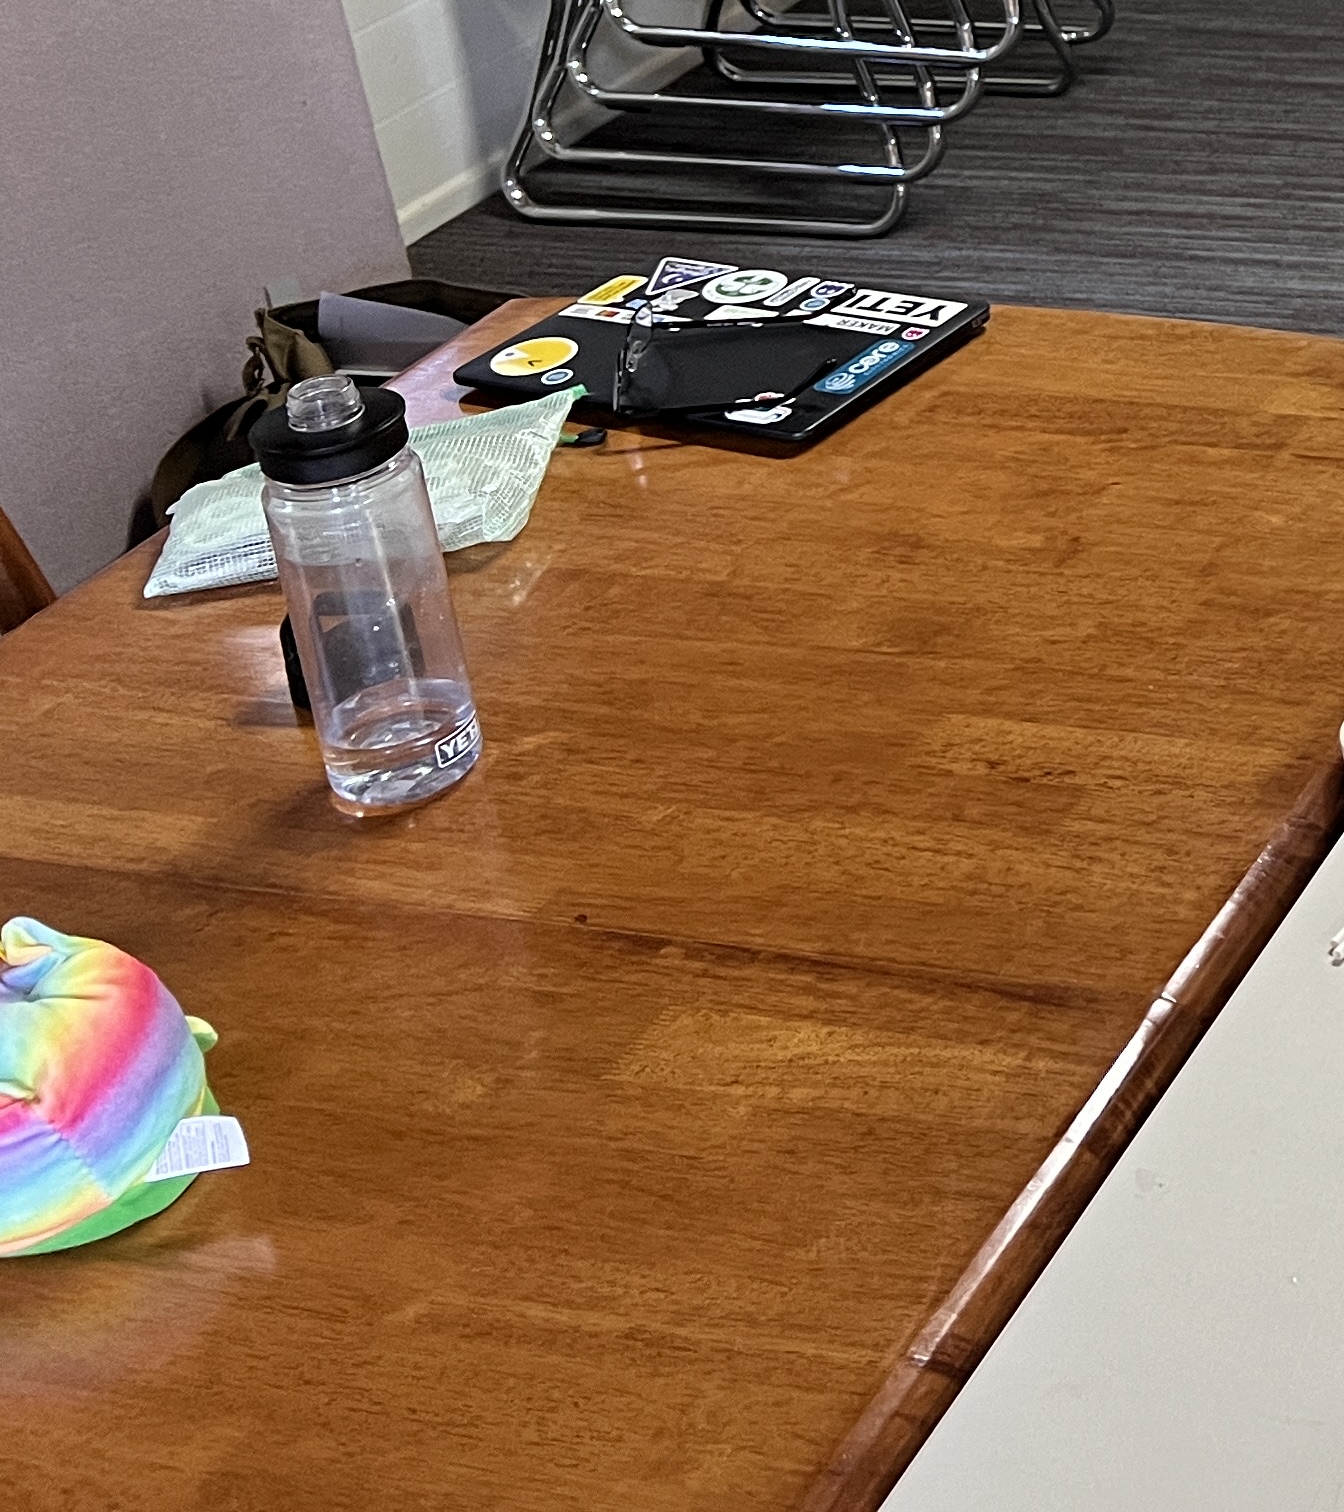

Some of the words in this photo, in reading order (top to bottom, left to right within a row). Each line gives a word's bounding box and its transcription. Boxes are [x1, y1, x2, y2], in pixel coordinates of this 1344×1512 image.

[844, 294, 948, 321] YETI
[836, 318, 895, 333] MAKER
[848, 341, 901, 375] core
